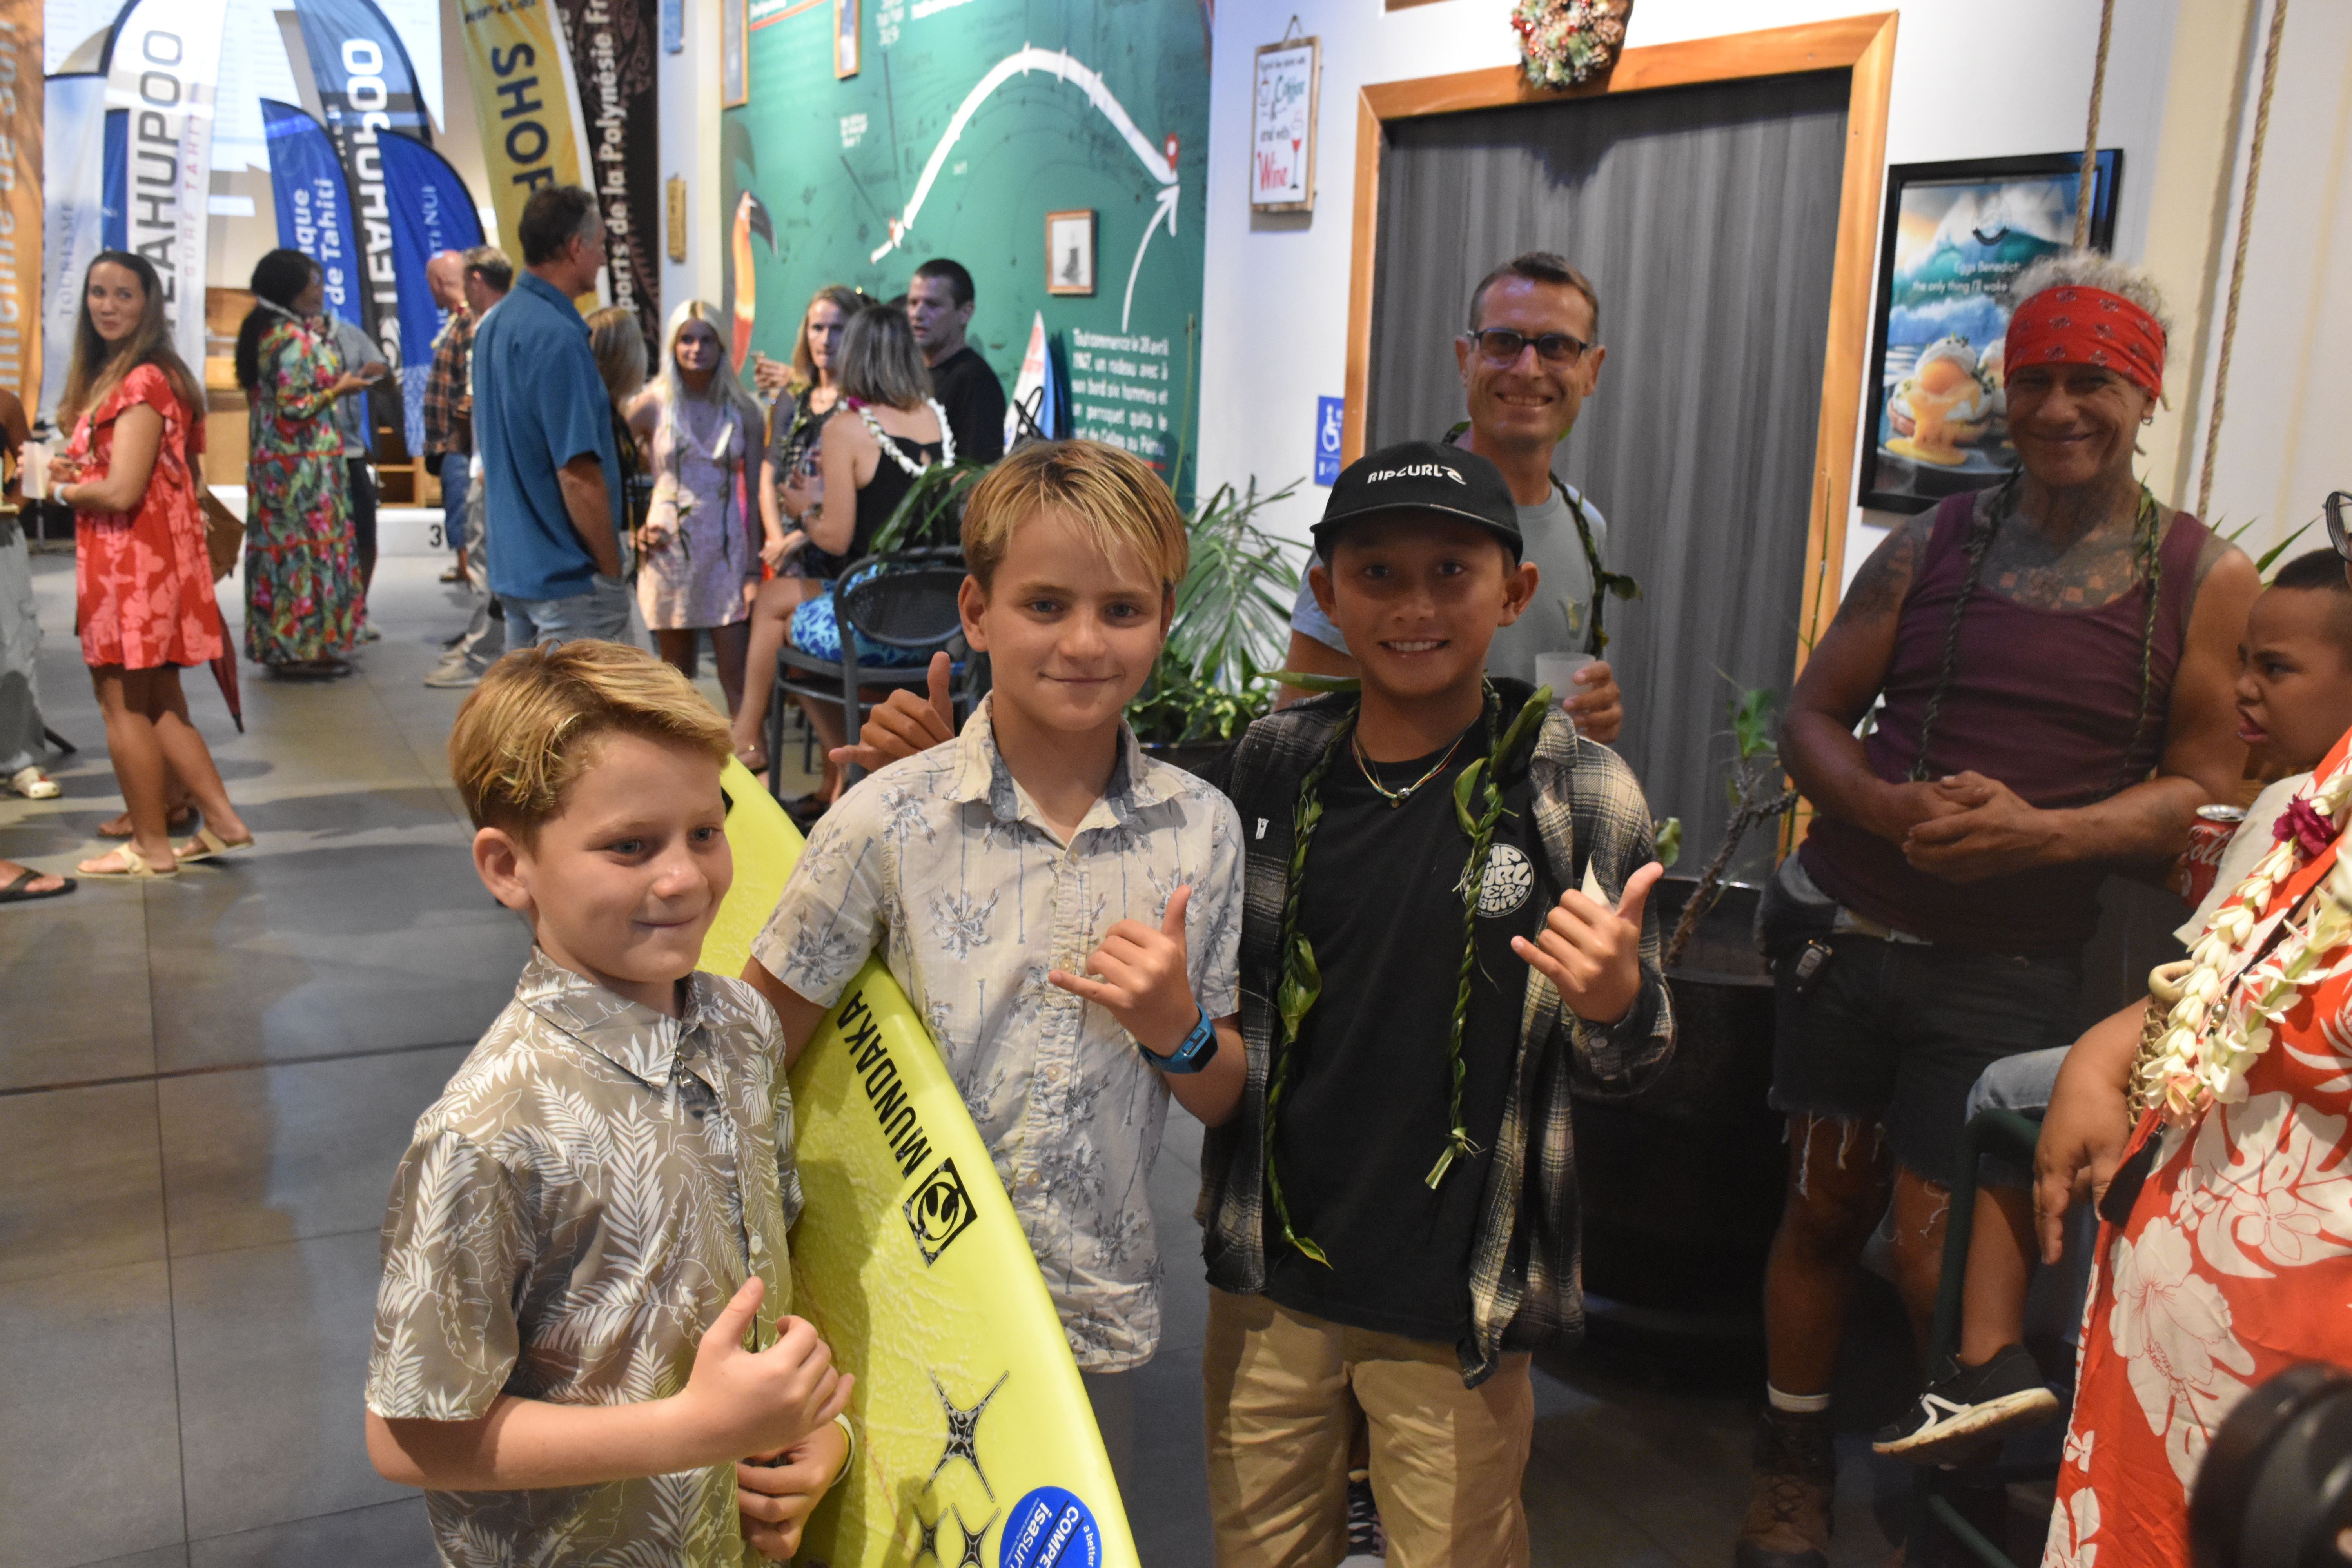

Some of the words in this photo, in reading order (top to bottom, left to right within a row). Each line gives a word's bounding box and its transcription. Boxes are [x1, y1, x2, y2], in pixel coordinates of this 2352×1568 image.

[590, 33, 627, 161] Polynésie
[601, 168, 626, 195] la
[1257, 151, 1288, 191] Wine
[313, 177, 341, 262] Tahiti
[422, 186, 439, 225] NUI
[606, 203, 629, 235] de
[1954, 261, 1976, 276] Eggs
[1978, 260, 2022, 273] Benedict
[324, 267, 346, 306] de
[1912, 281, 1926, 292] the
[1928, 281, 1946, 294] only
[1948, 279, 1971, 295] thing
[1983, 281, 2008, 292] wake
[430, 523, 443, 548] 3
[1481, 862, 1532, 887] URL
[1488, 846, 1522, 867] IP
[837, 990, 932, 1179] MUNDAKA
[1010, 1502, 1053, 1568] isasur
[1036, 1506, 1079, 1568] COMPE
[1086, 1534, 1096, 1567] better
